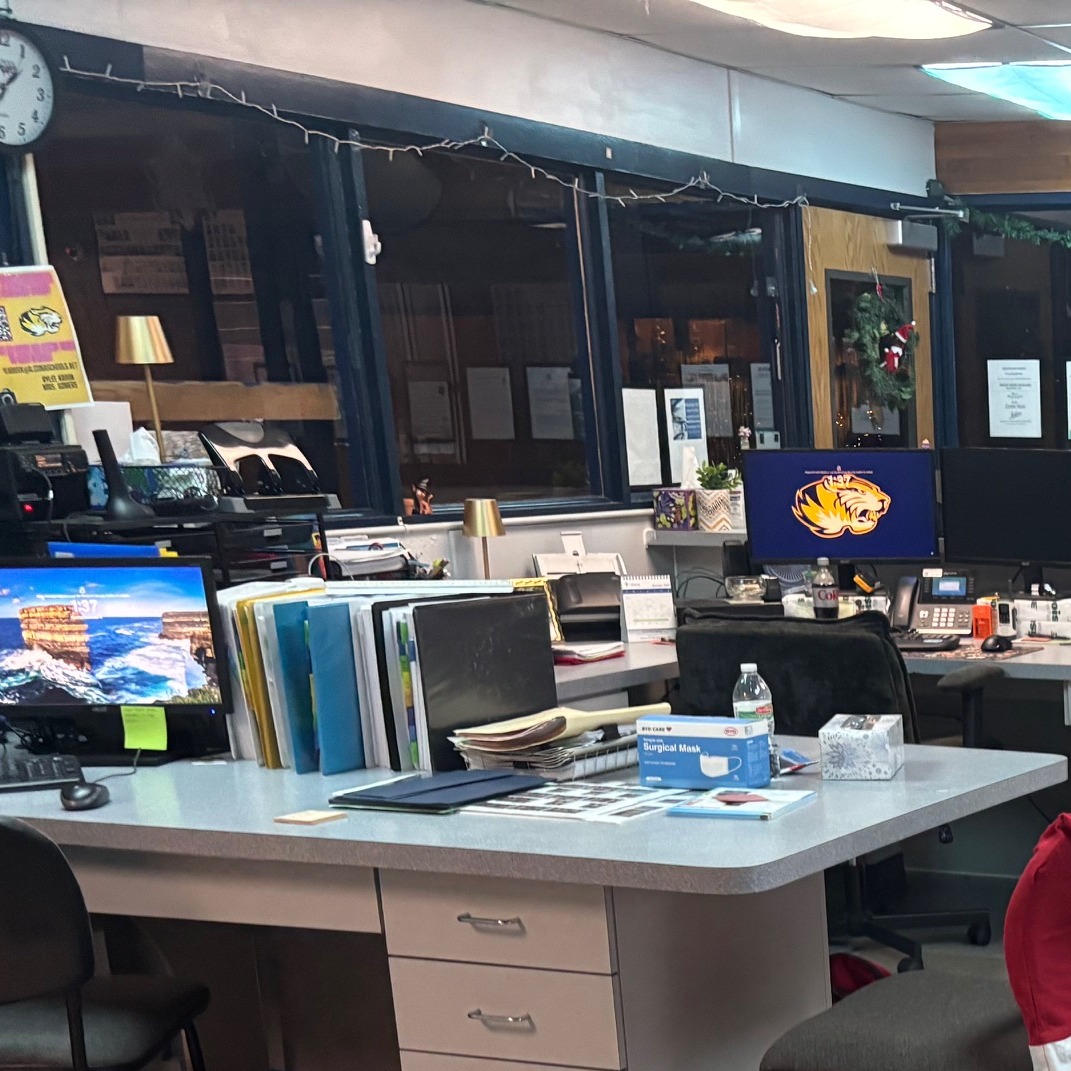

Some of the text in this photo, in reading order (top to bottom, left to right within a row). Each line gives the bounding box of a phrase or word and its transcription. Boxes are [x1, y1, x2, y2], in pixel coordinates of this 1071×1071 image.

[20, 44, 25, 59] 1
[32, 64, 41, 79] 2
[36, 87, 45, 102] 3
[31, 109, 39, 123] 4
[17, 122, 26, 136] 5
[817, 589, 839, 601] Cok
[643, 742, 701, 753] Surgical Mask
